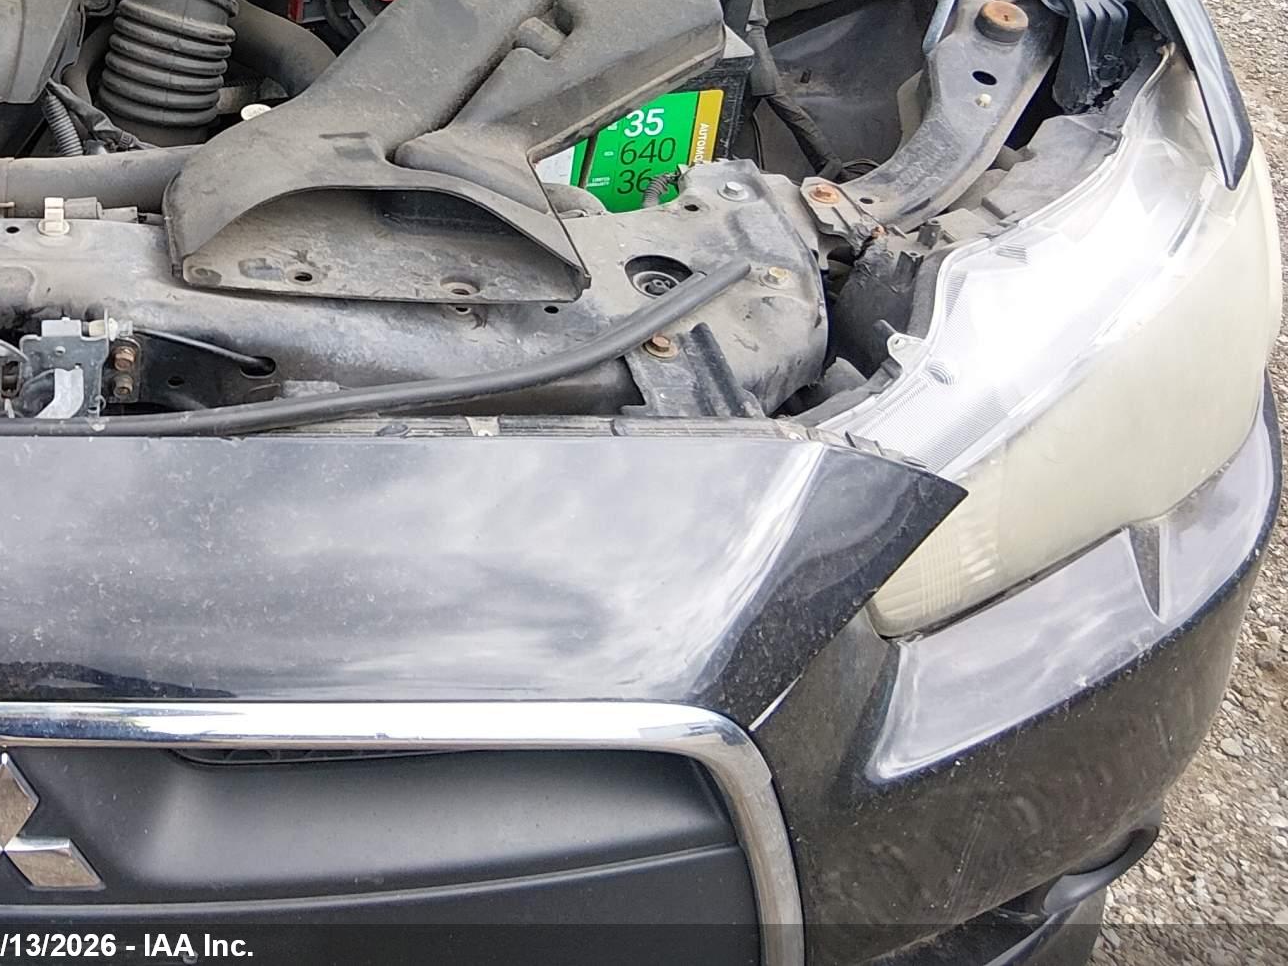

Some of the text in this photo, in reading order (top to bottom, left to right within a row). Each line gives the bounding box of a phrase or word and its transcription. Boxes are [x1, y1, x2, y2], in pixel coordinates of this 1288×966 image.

[623, 108, 665, 137] 35
[619, 137, 677, 165] 640
[616, 168, 653, 195] 36
